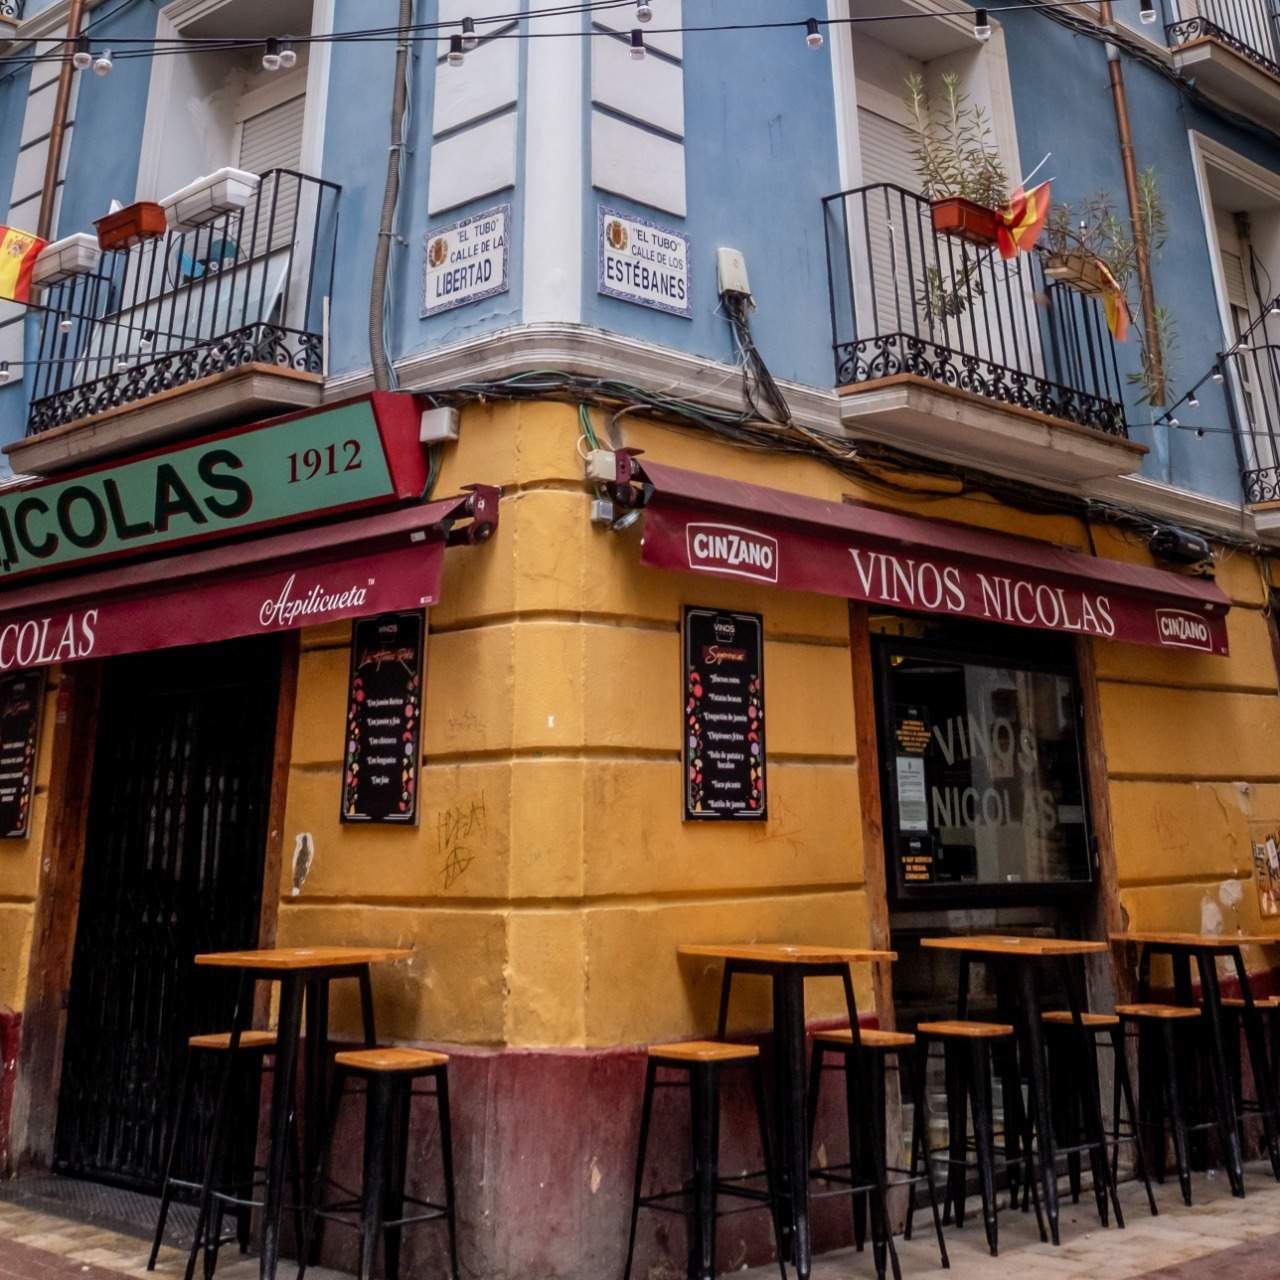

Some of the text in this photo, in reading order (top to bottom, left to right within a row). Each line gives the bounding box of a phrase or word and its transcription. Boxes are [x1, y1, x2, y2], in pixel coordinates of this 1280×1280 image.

[450, 235, 504, 264] CALLE DE LA
[631, 244, 684, 271] CALLE DE LOS
[436, 258, 492, 298] LIBERTAD
[606, 256, 685, 301] ESTÉBANES
[286, 438, 364, 485] 1912
[693, 531, 774, 571] CINZANO
[848, 548, 1117, 638] VINOS NICOLAS
[1160, 616, 1208, 642] CINZANO
[932, 713, 1039, 772] VINOS
[931, 785, 1057, 831] NICOLAS
